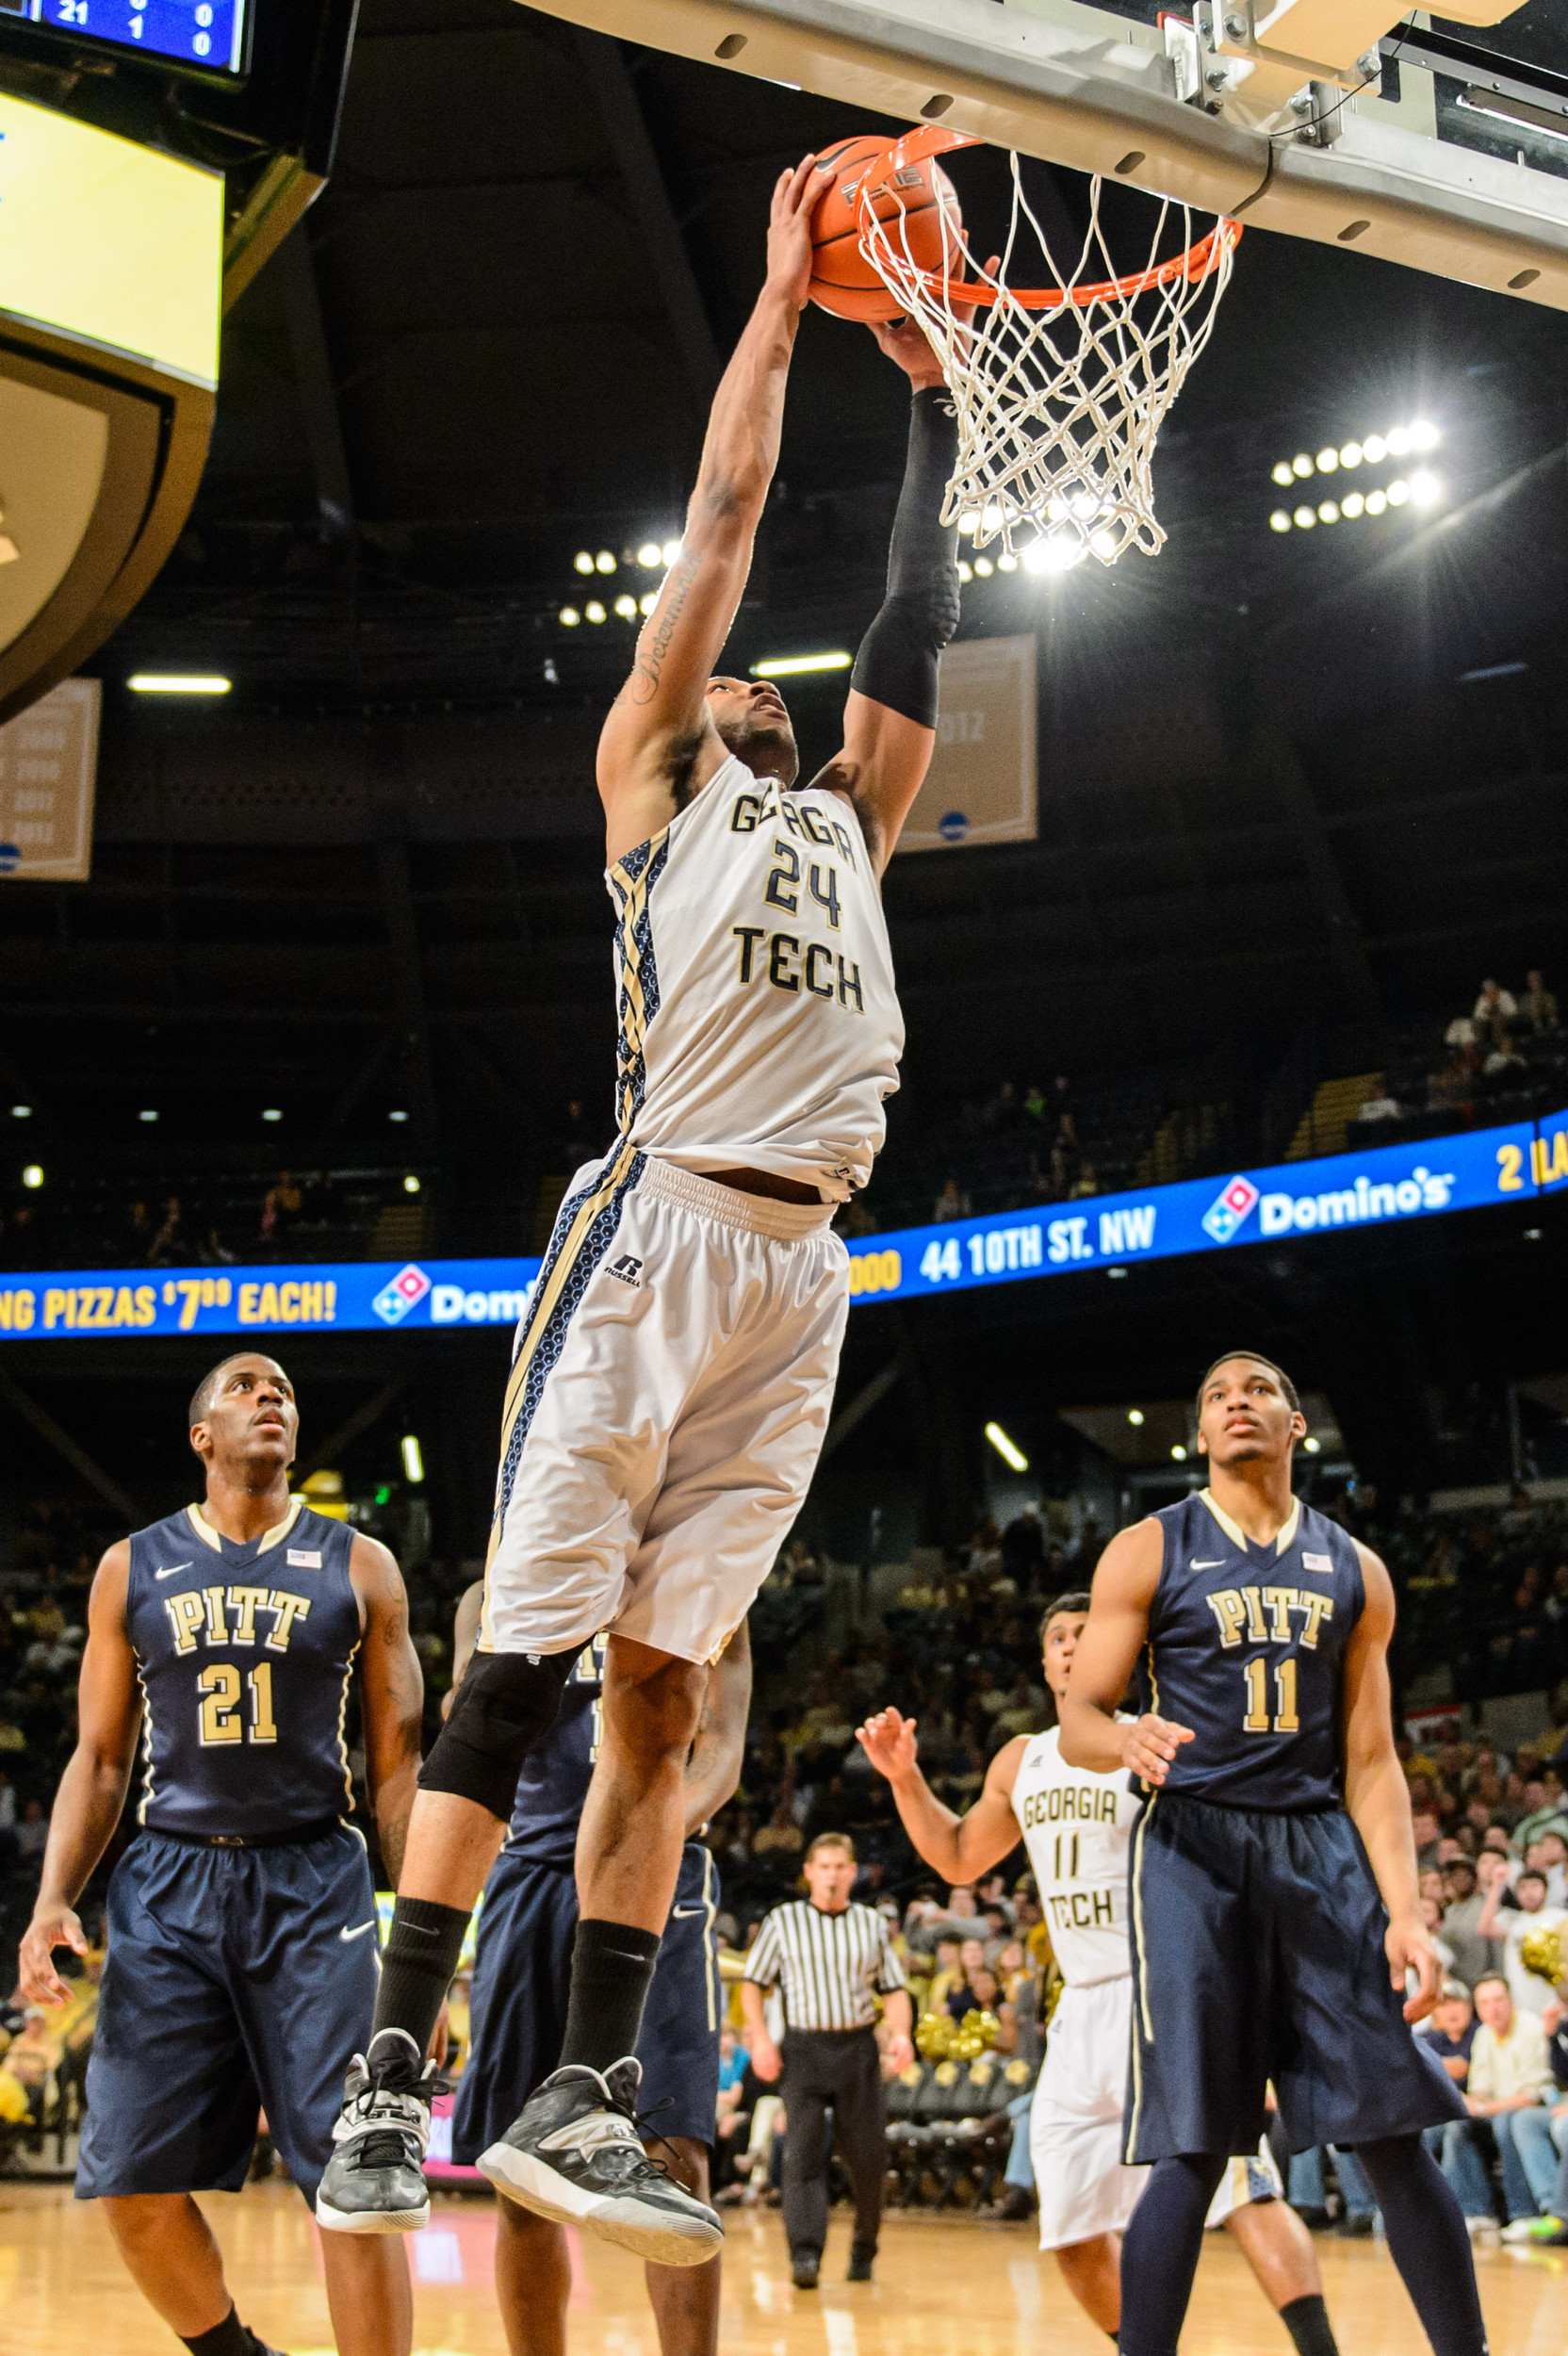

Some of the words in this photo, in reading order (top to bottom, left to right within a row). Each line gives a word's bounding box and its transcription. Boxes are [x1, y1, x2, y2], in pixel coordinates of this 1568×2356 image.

[57, 0, 89, 25] 21
[128, 14, 143, 40] 1
[192, 31, 212, 57] 0
[194, 3, 213, 27] 0
[730, 780, 858, 875] GERGA
[763, 835, 842, 932] 24
[730, 925, 866, 1015] TECH
[1495, 1143, 1524, 1192] 2
[1259, 1166, 1457, 1236] Domino's
[604, 1267, 641, 1288] RUSSELL
[849, 1249, 902, 1296] 000
[919, 1237, 962, 1284] 44
[968, 1223, 1043, 1276] 10TH
[1048, 1216, 1094, 1264] ST.
[1099, 1204, 1157, 1255] NW
[43, 1284, 157, 1330] PIZZAS
[238, 1280, 337, 1324] EACH!
[430, 1282, 539, 1323] Dom
[164, 1585, 312, 1657] PITT
[1205, 1585, 1334, 1650] PITT
[197, 1661, 278, 1747] 21
[1243, 1657, 1299, 1733] 11
[1023, 1786, 1117, 1831] GEORGIA
[1053, 1830, 1079, 1880] 11
[1048, 1890, 1113, 1930] TECH
